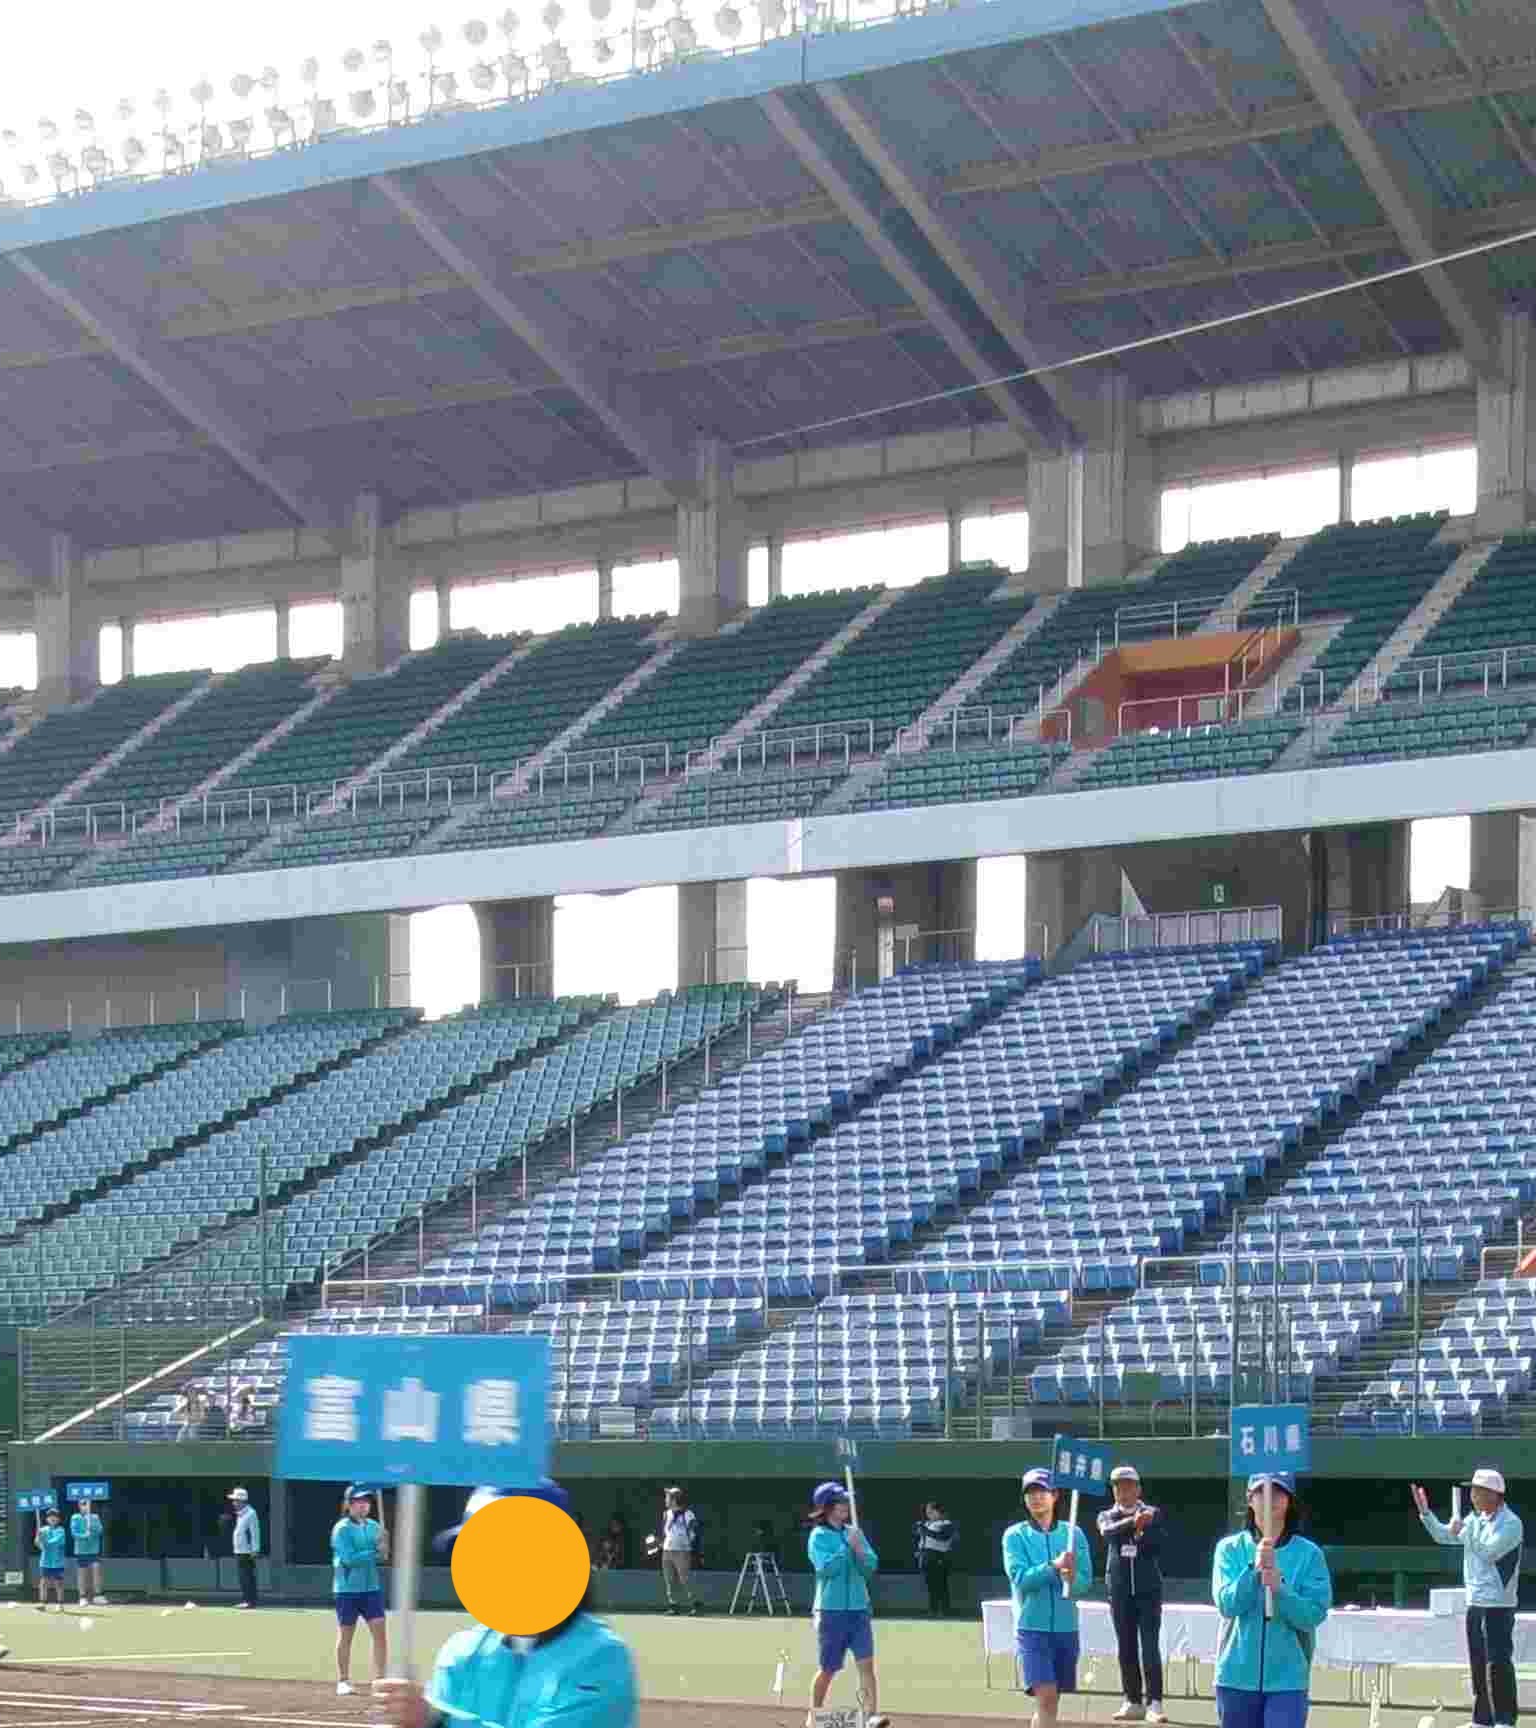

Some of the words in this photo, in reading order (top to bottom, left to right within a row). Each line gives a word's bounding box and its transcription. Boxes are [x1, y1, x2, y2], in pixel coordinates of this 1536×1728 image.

[304, 1375, 521, 1446] 富山県
[1240, 1424, 1301, 1456] 石川県
